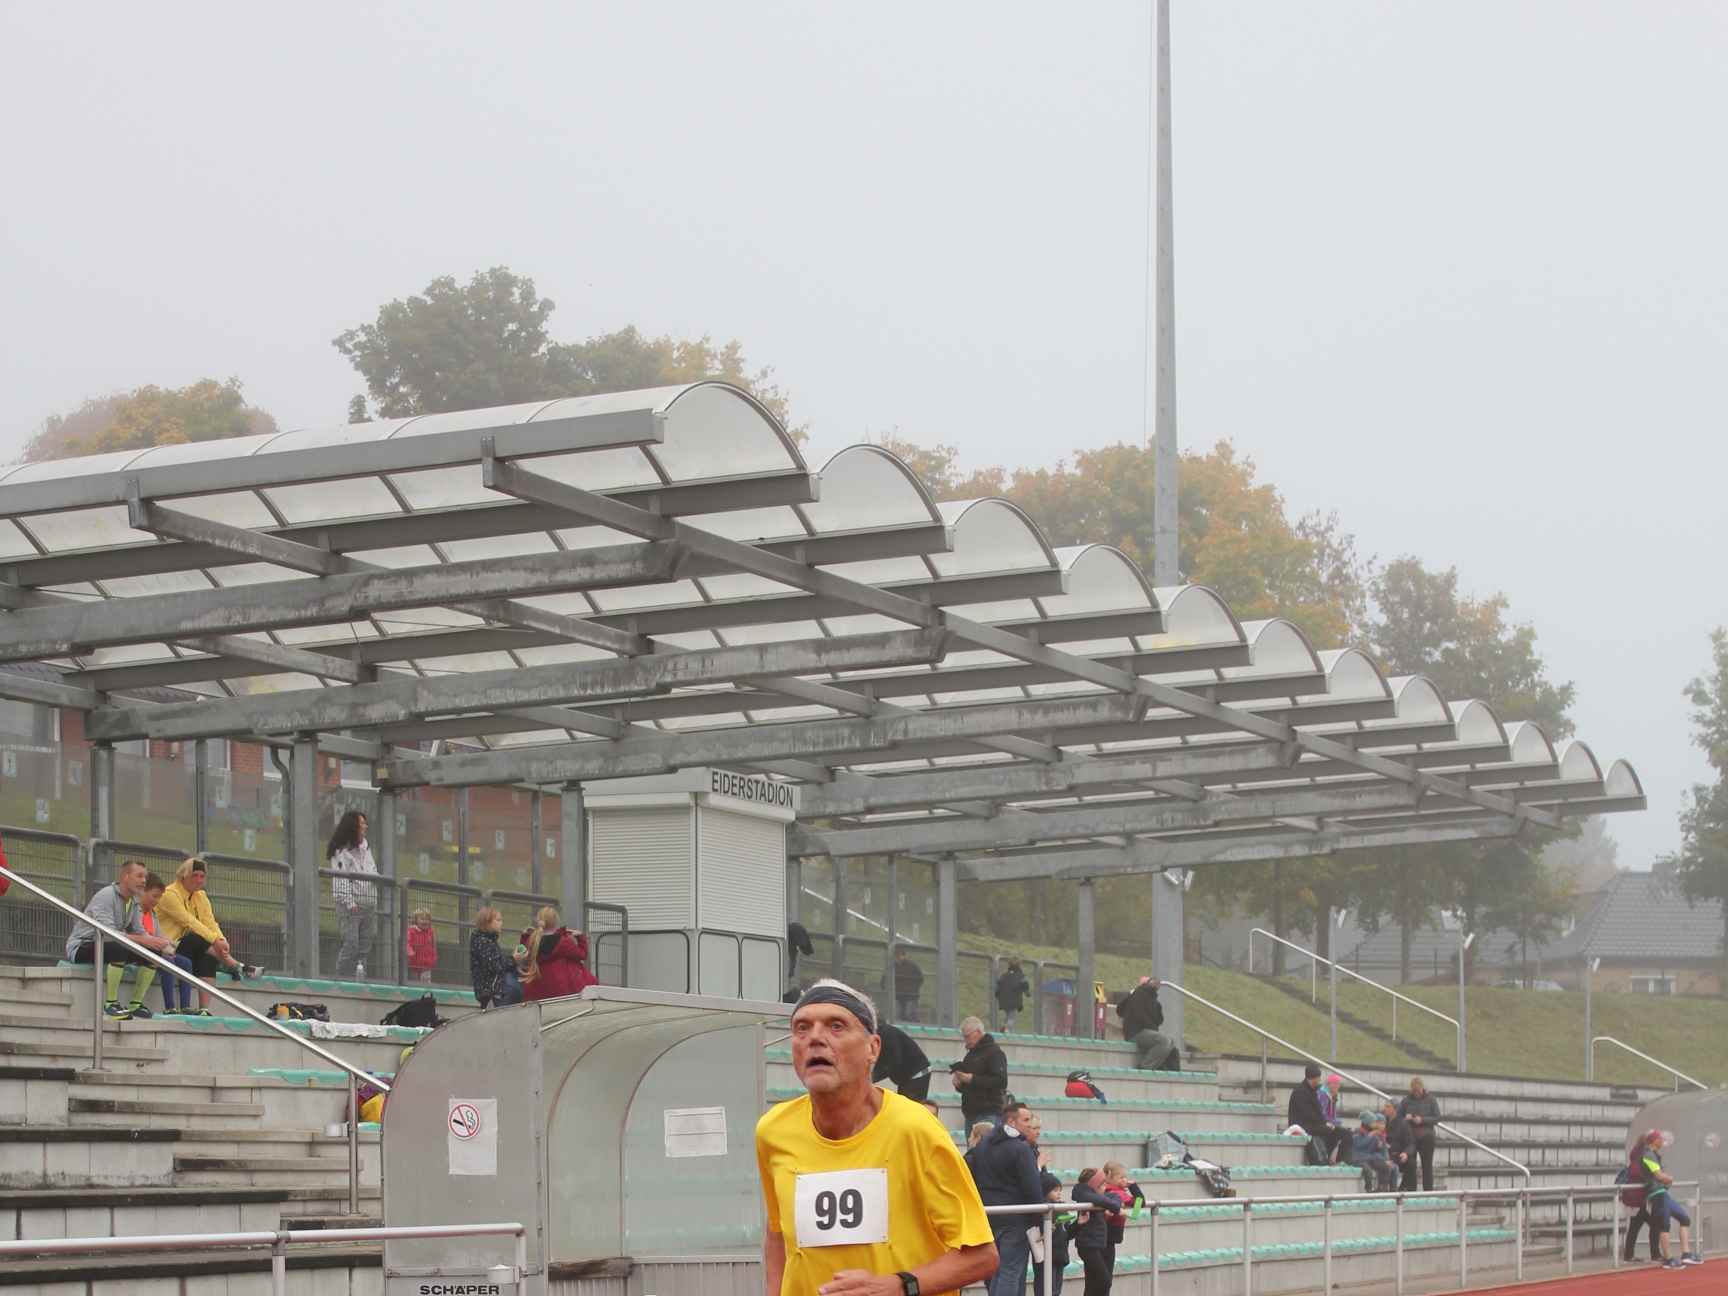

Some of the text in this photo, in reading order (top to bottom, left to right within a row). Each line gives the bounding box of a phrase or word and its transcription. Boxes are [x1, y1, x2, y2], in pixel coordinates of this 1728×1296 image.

[711, 770, 794, 808] EIDERSTADION
[815, 1188, 863, 1230] 99
[420, 1284, 500, 1296] SCHÄPER
